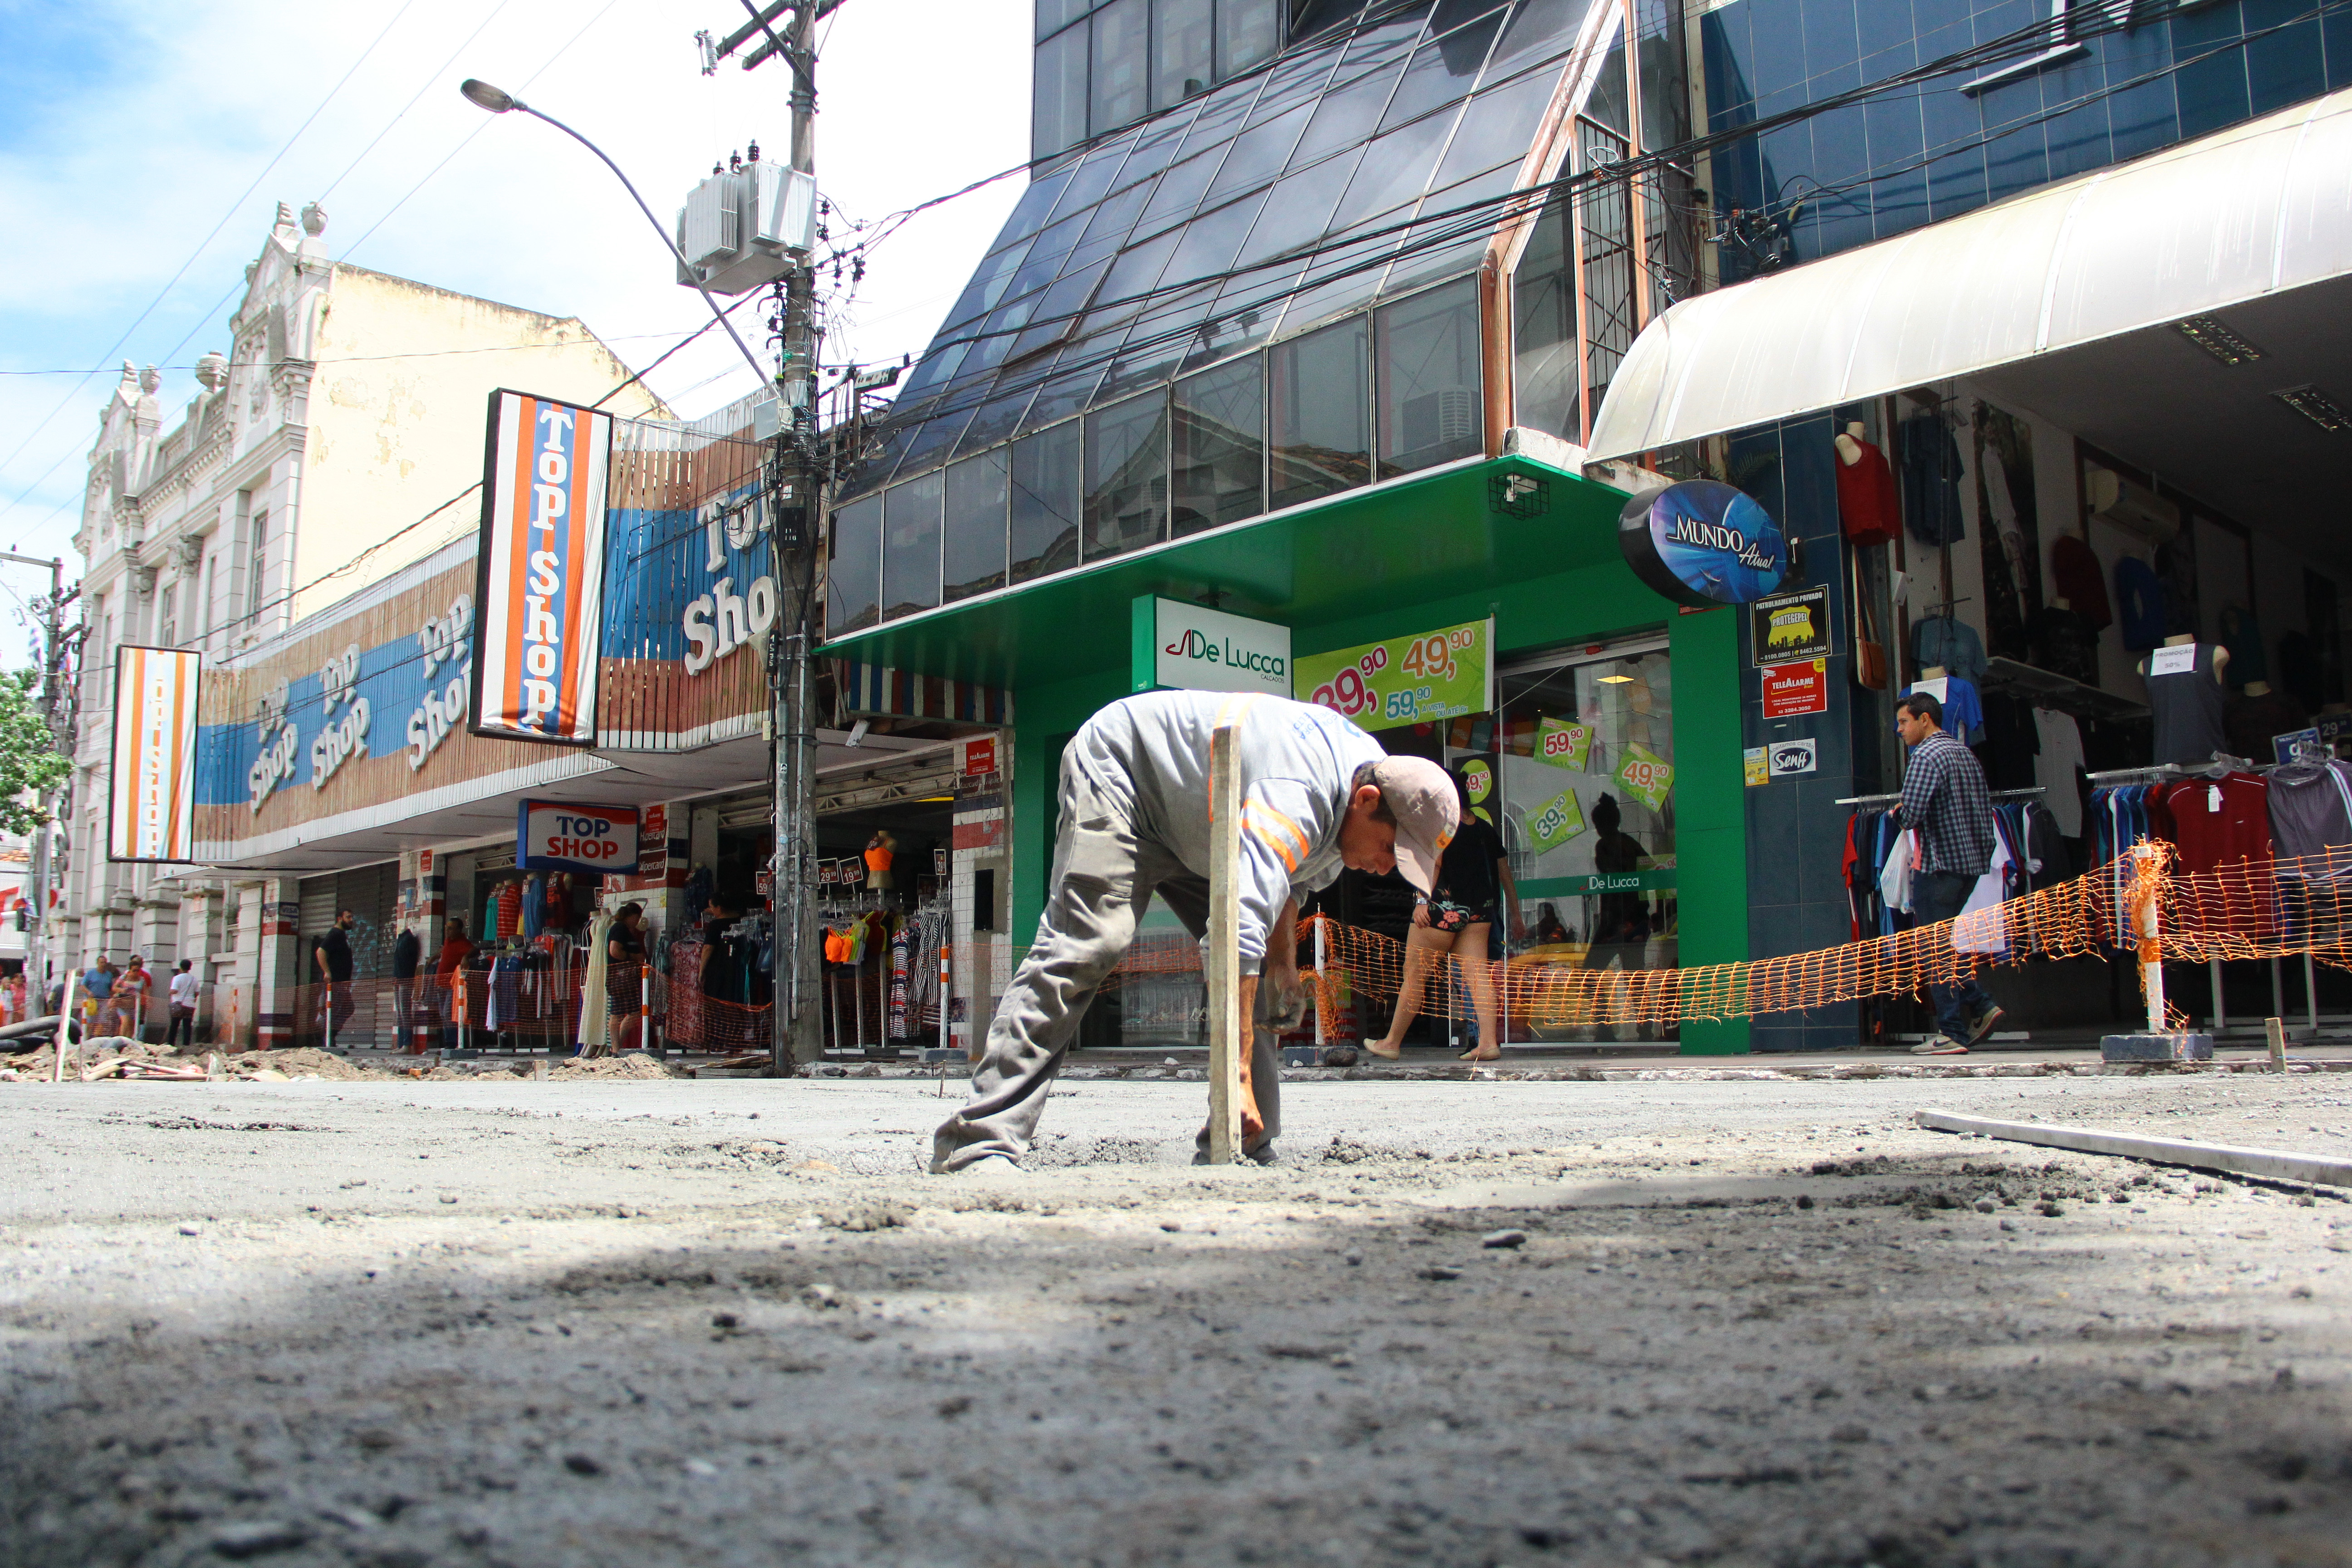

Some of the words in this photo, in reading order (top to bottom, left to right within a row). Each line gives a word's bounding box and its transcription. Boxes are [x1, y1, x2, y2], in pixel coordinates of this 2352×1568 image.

[1667, 514, 1743, 552] MUNDO
[1739, 543, 1774, 568] Atual
[1756, 596, 1798, 610] PATRULHAMENTO
[1799, 591, 1823, 602] PRIVADO
[684, 575, 779, 676] Sho
[1772, 612, 1808, 627] PROTEGEPEL
[418, 594, 472, 679] Top
[1191, 629, 1220, 662] De
[1226, 637, 1284, 676] Lucca
[1799, 645, 1826, 655] 8462.5594
[319, 644, 361, 715] Top
[1260, 674, 1285, 683] CALÇADOS
[1429, 702, 1445, 711] VISTA
[1447, 705, 1459, 715] ATÉ
[312, 697, 371, 790] Shop
[1769, 742, 1796, 754] Aceitamos
[249, 723, 298, 814] Shop
[1774, 751, 1808, 769] Senff
[556, 816, 611, 838] TOP
[547, 836, 618, 859] SHOP
[1590, 876, 1605, 889] De
[1607, 875, 1639, 888] Lucca
